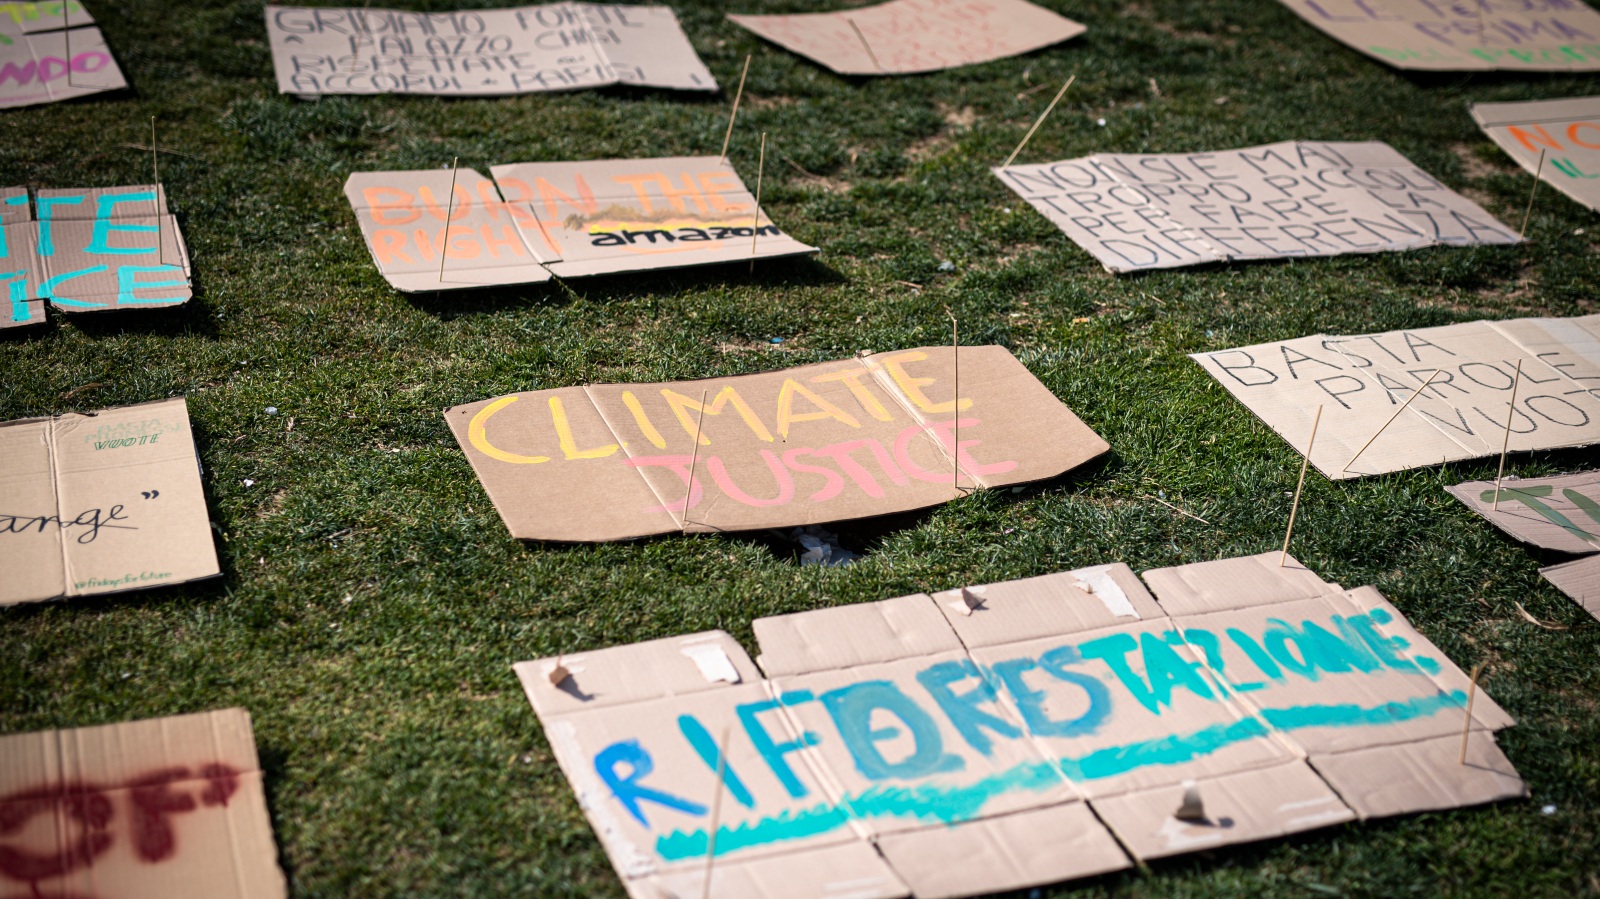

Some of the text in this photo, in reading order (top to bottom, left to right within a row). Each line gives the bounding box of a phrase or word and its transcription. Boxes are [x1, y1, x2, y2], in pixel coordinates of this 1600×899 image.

[275, 9, 486, 36] GRIDIAMO
[349, 33, 513, 56] PALAZZO
[291, 51, 536, 74] RISPETTATE
[1238, 142, 1354, 175] MAI
[361, 170, 756, 227] BURN THE
[1027, 166, 1444, 215] TROPPO PICCOLI
[1070, 188, 1447, 238] PER FARE LA
[370, 218, 566, 265] RIGHT
[591, 225, 783, 247] amazon
[1099, 209, 1518, 267] DIFFERENZA
[1208, 331, 1457, 387] BASTA
[1315, 351, 1600, 410] PAROLE
[467, 350, 974, 465] CLIMATE
[94, 432, 164, 451] VUOTE
[620, 417, 1019, 514] JUSTICE
[592, 606, 1443, 829] RIFORESTAZIONE
